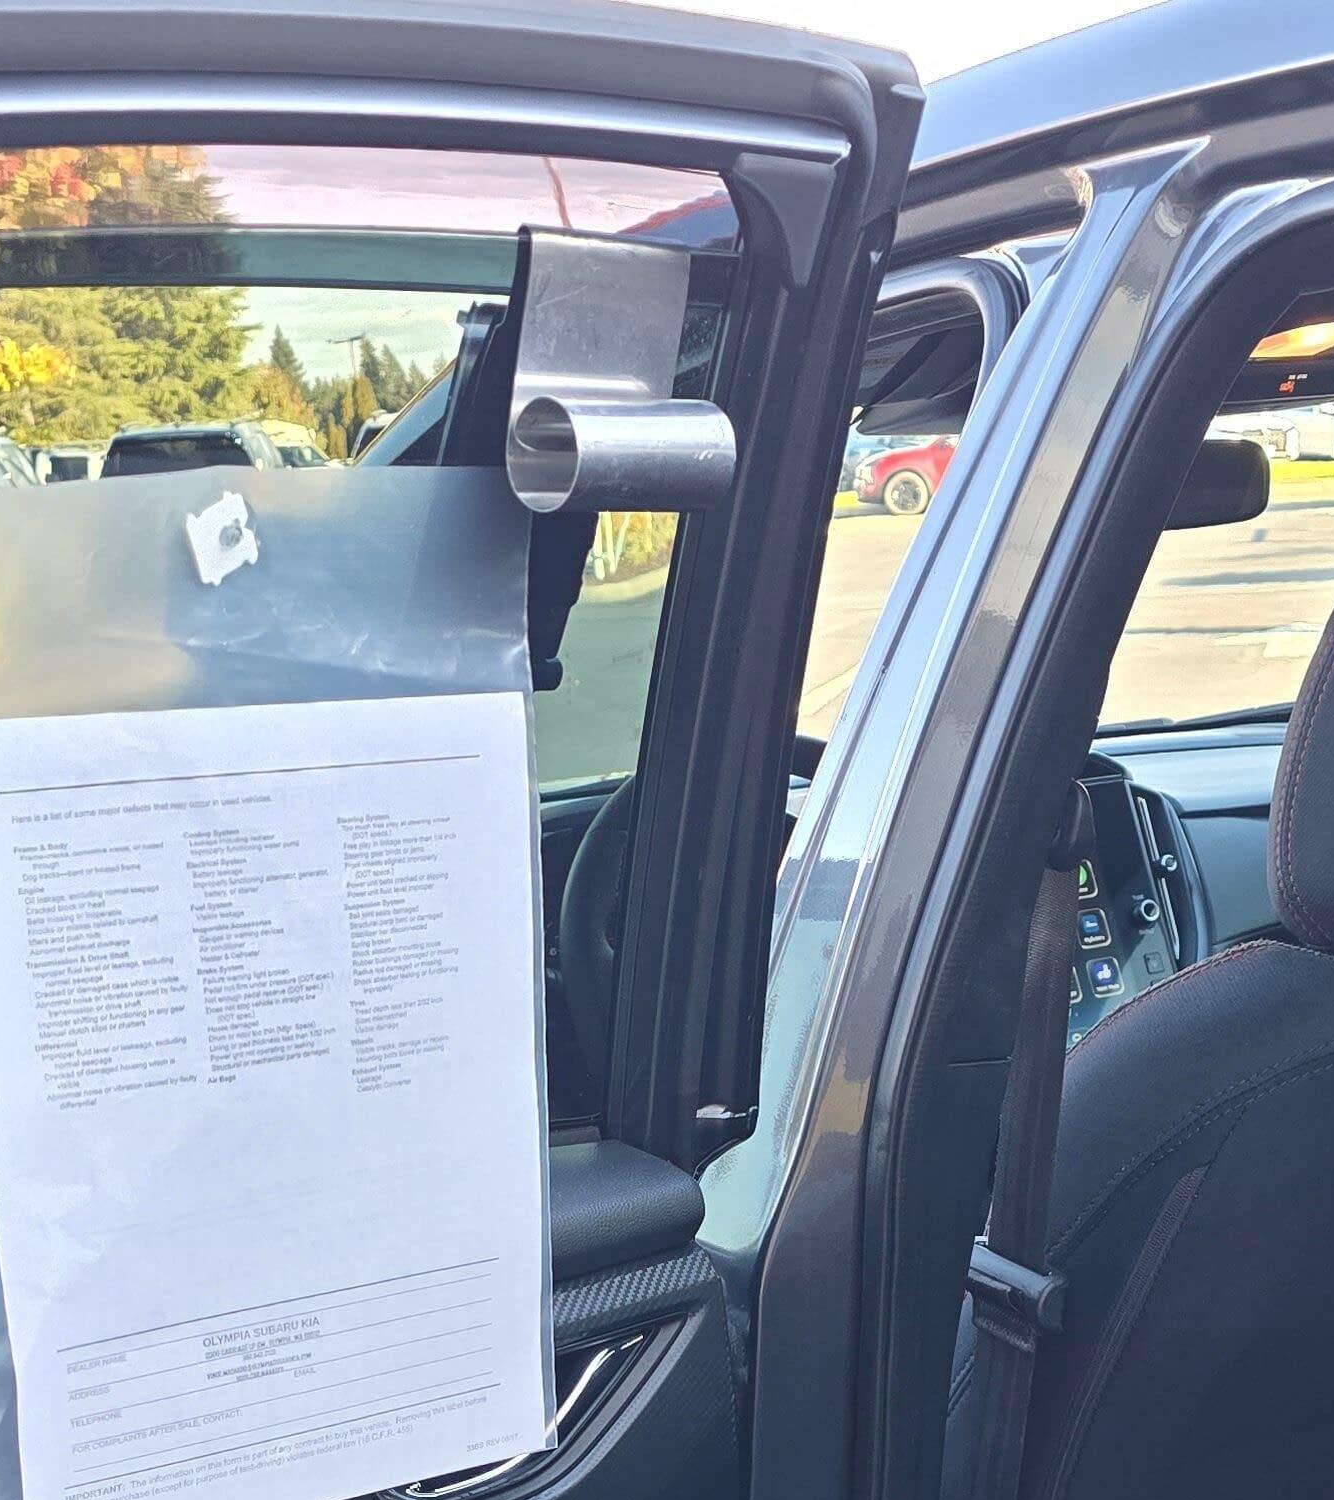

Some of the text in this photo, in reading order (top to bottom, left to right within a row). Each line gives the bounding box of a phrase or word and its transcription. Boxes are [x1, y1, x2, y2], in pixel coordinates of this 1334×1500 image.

[203, 1331, 251, 1348] OLYMPIA
[253, 1321, 299, 1338] SUBARU
[301, 1318, 320, 1329] KIA
[67, 1354, 127, 1374] DEALER NAME
[294, 1366, 316, 1377] EMAIL
[68, 1385, 110, 1402] ADDRESS
[71, 1410, 122, 1428] TELEPHONE
[72, 1444, 91, 1454] FOR
[92, 1431, 147, 1450] COMPLAINTS
[148, 1425, 177, 1437] AFTER
[202, 1410, 243, 1425] CONTACT:
[130, 1480, 147, 1489] The
[149, 1469, 194, 1485] information
[208, 1463, 223, 1471] this
[223, 1458, 242, 1468] form
[252, 1451, 268, 1463] part
[269, 1448, 279, 1457] of
[279, 1447, 292, 1455] any
[294, 1435, 324, 1449] contract
[335, 1430, 348, 1439] buy
[350, 1427, 363, 1435] this
[395, 1410, 432, 1424] Removing
[433, 1406, 445, 1415] this
[152, 1480, 182, 1496] (except
[183, 1479, 194, 1487] for
[196, 1471, 228, 1486] purpose
[229, 1467, 238, 1476] of
[316, 1442, 343, 1455] federal
[344, 1440, 356, 1448] law
